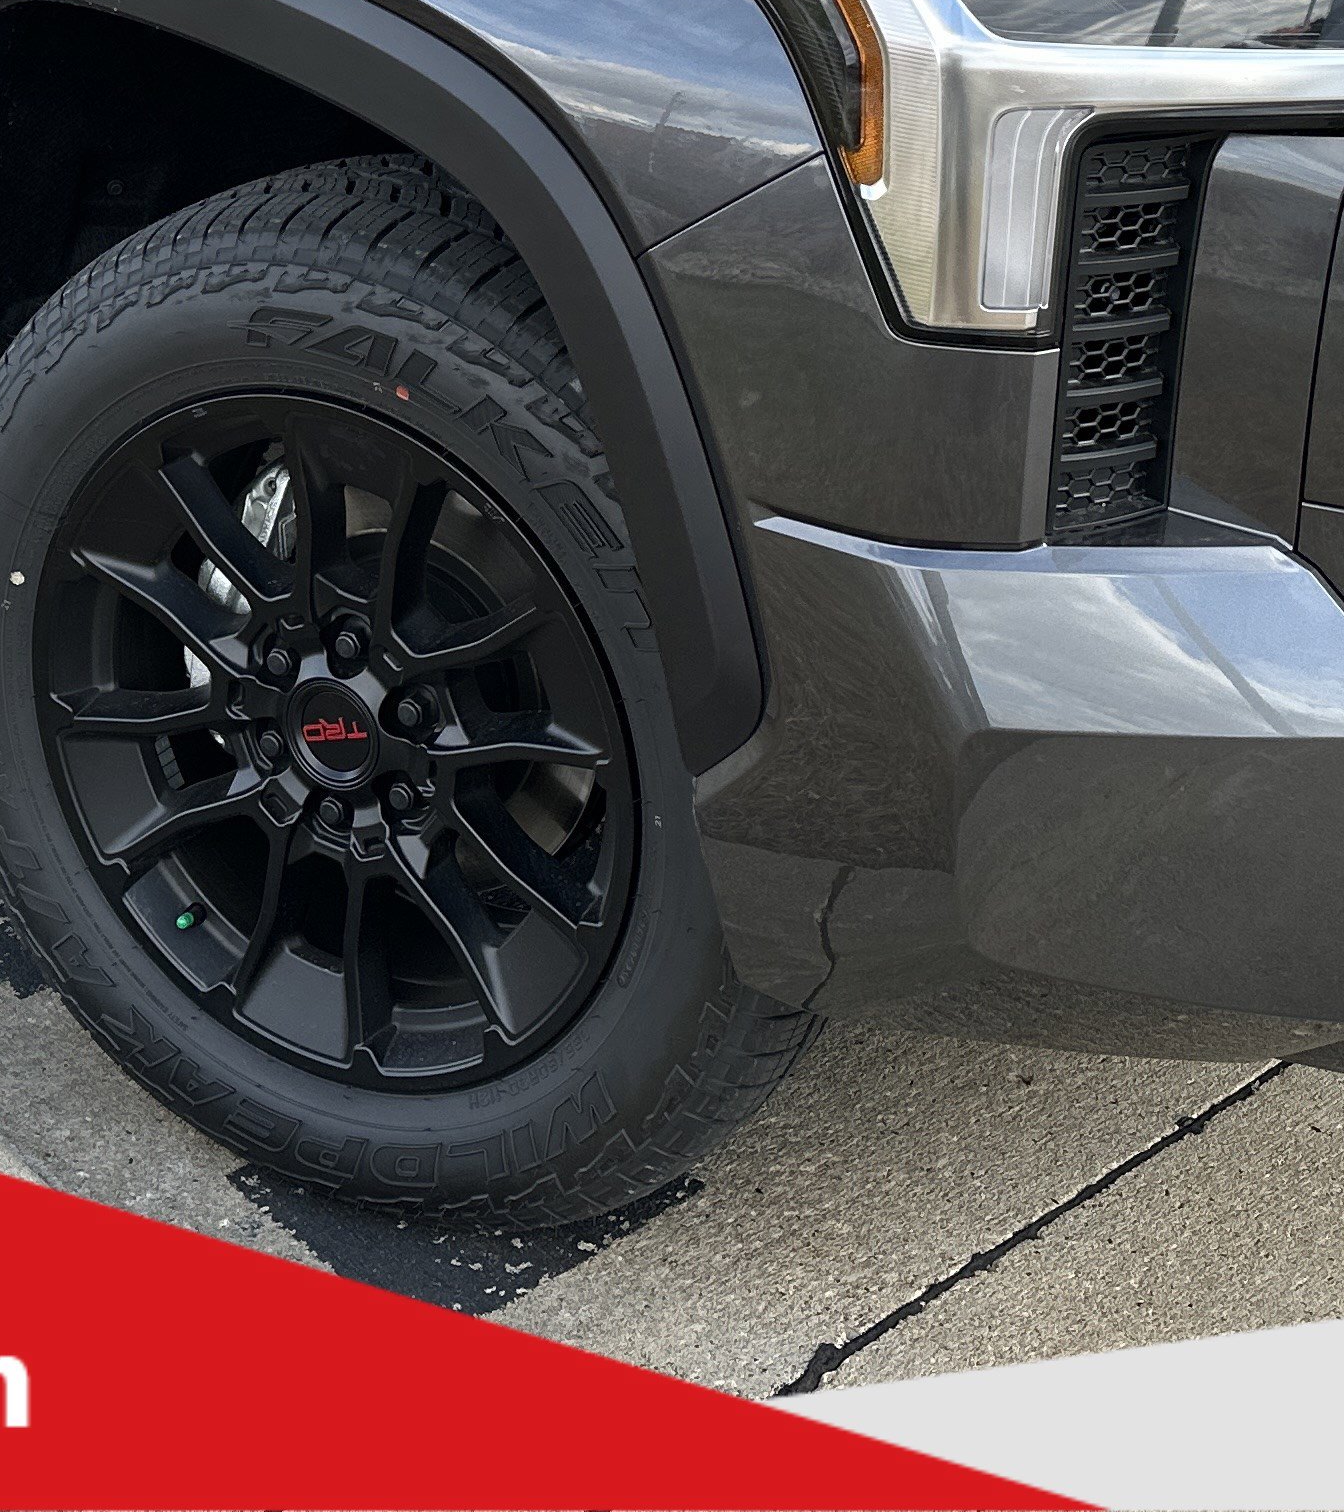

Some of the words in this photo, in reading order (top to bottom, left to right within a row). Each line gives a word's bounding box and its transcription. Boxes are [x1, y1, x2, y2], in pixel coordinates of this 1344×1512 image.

[227, 306, 658, 653] FALKEN
[303, 716, 368, 743] TRD
[100, 1005, 618, 1189] WILDPEAK
